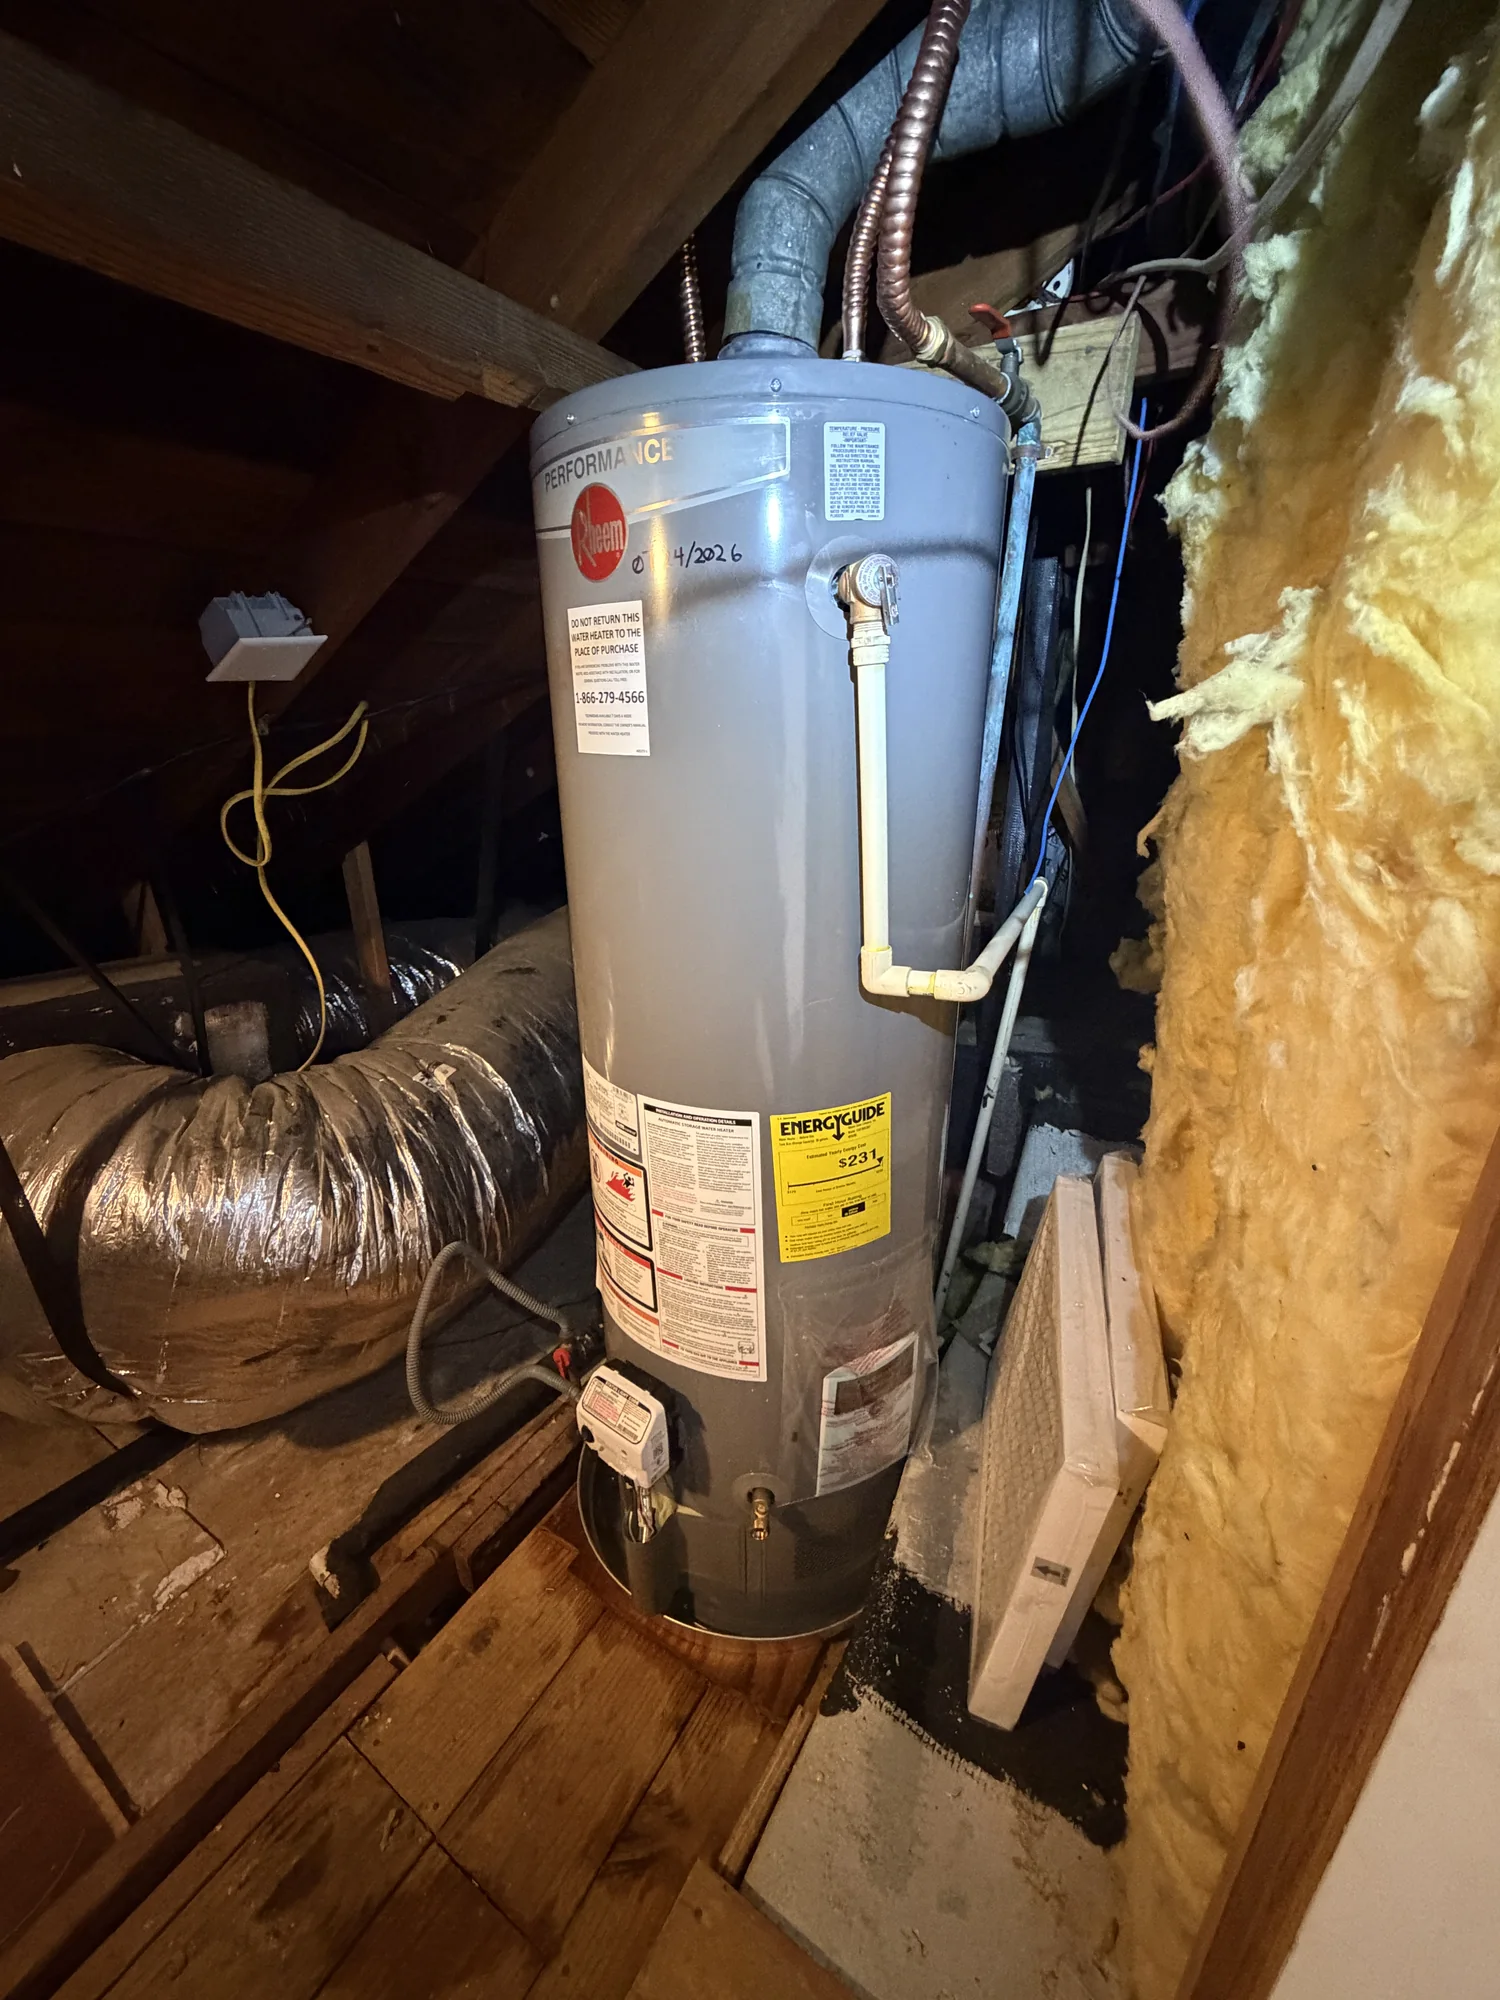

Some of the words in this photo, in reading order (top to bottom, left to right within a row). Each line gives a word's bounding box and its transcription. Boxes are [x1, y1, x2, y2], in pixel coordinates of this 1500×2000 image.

[544, 437, 673, 492] PERFORMANCE
[576, 489, 624, 567] Rheem
[571, 618, 580, 628] DO
[580, 617, 592, 627] NOT
[594, 614, 620, 626] RETURN
[623, 613, 640, 623] THIS
[571, 632, 589, 642] WATER
[590, 630, 614, 640] HEATER
[615, 629, 625, 638] TO
[627, 628, 641, 637] THE
[575, 647, 590, 656] PLACE
[592, 646, 599, 655] OF
[601, 644, 638, 654] PURCHASE
[576, 691, 645, 704] 1-866-279-4566
[656, 1108, 682, 1118] INSTALLATION
[658, 1117, 681, 1126] AUTOMATIC
[780, 1102, 885, 1140] ENERGYGUIDE
[839, 1148, 876, 1168] $231
